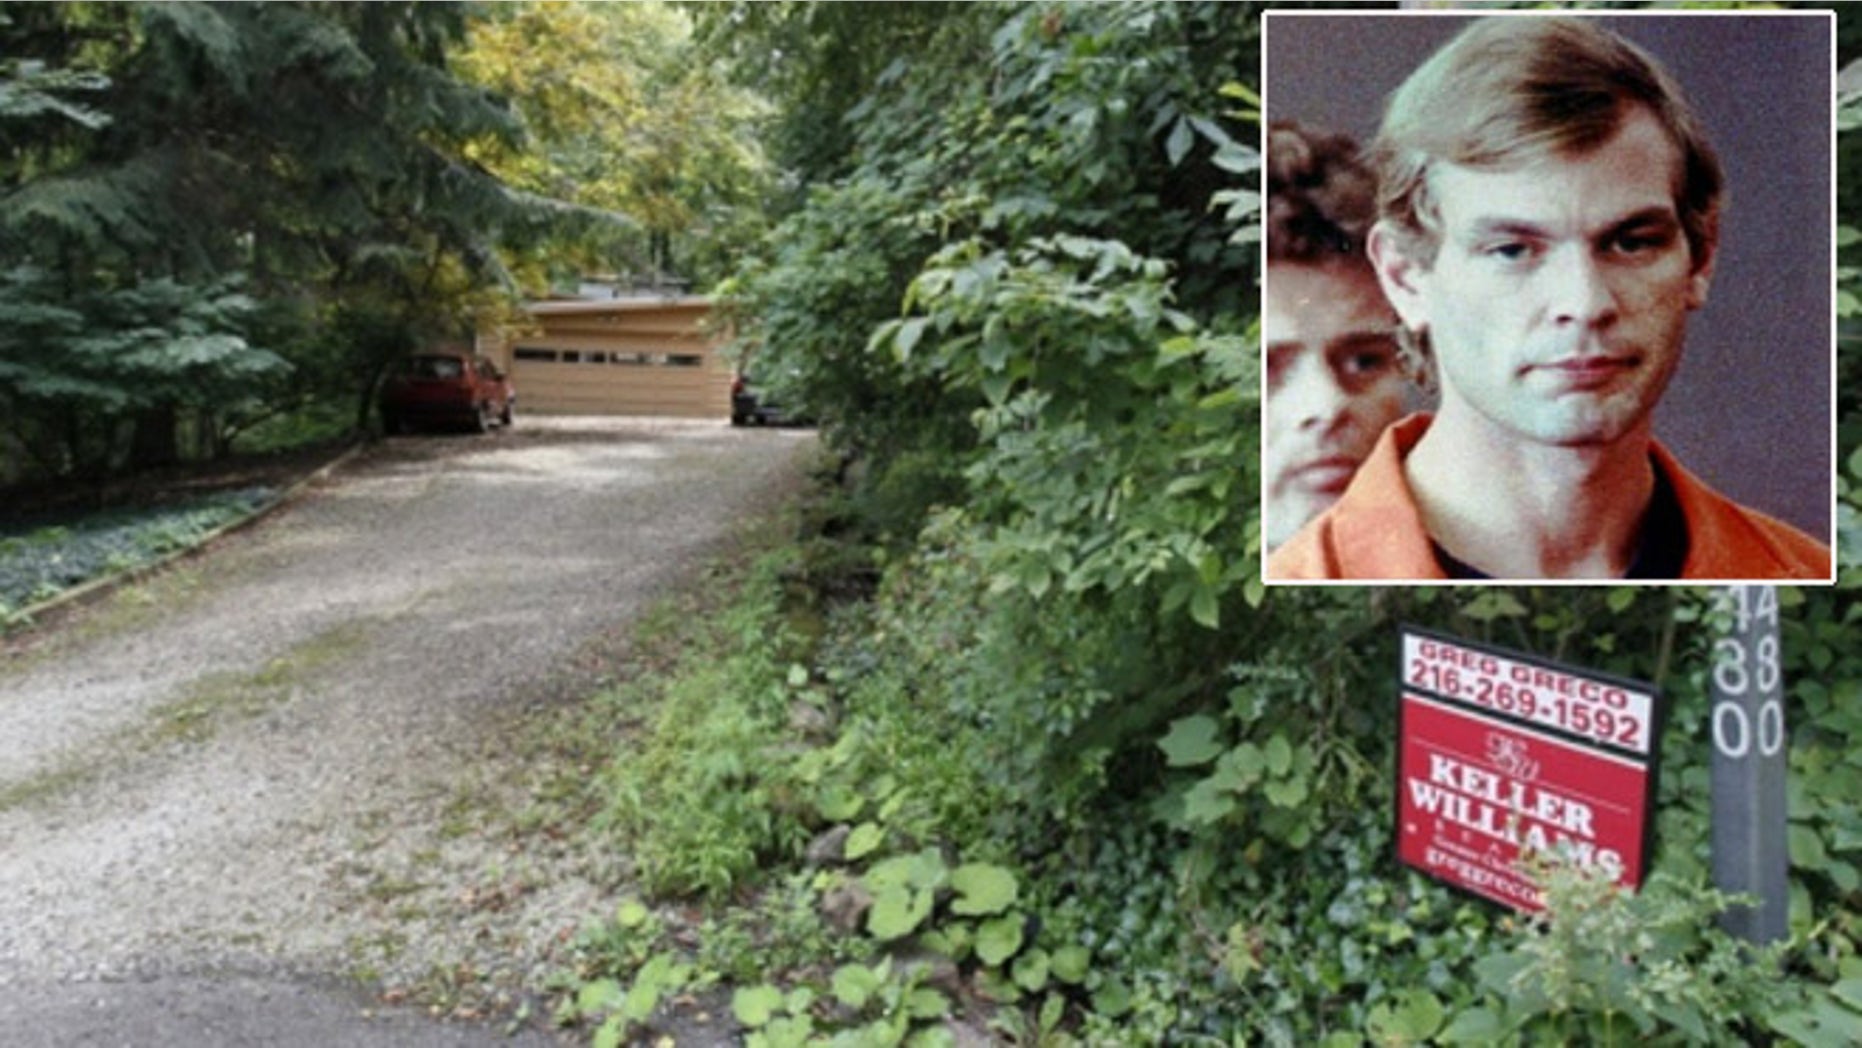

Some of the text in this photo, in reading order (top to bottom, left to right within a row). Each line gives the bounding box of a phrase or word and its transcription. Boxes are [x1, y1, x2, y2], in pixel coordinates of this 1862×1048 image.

[1411, 659, 1640, 747] 216-269-1592
[1418, 640, 1629, 710] GREG GRECO
[1430, 753, 1596, 839] KELLER
